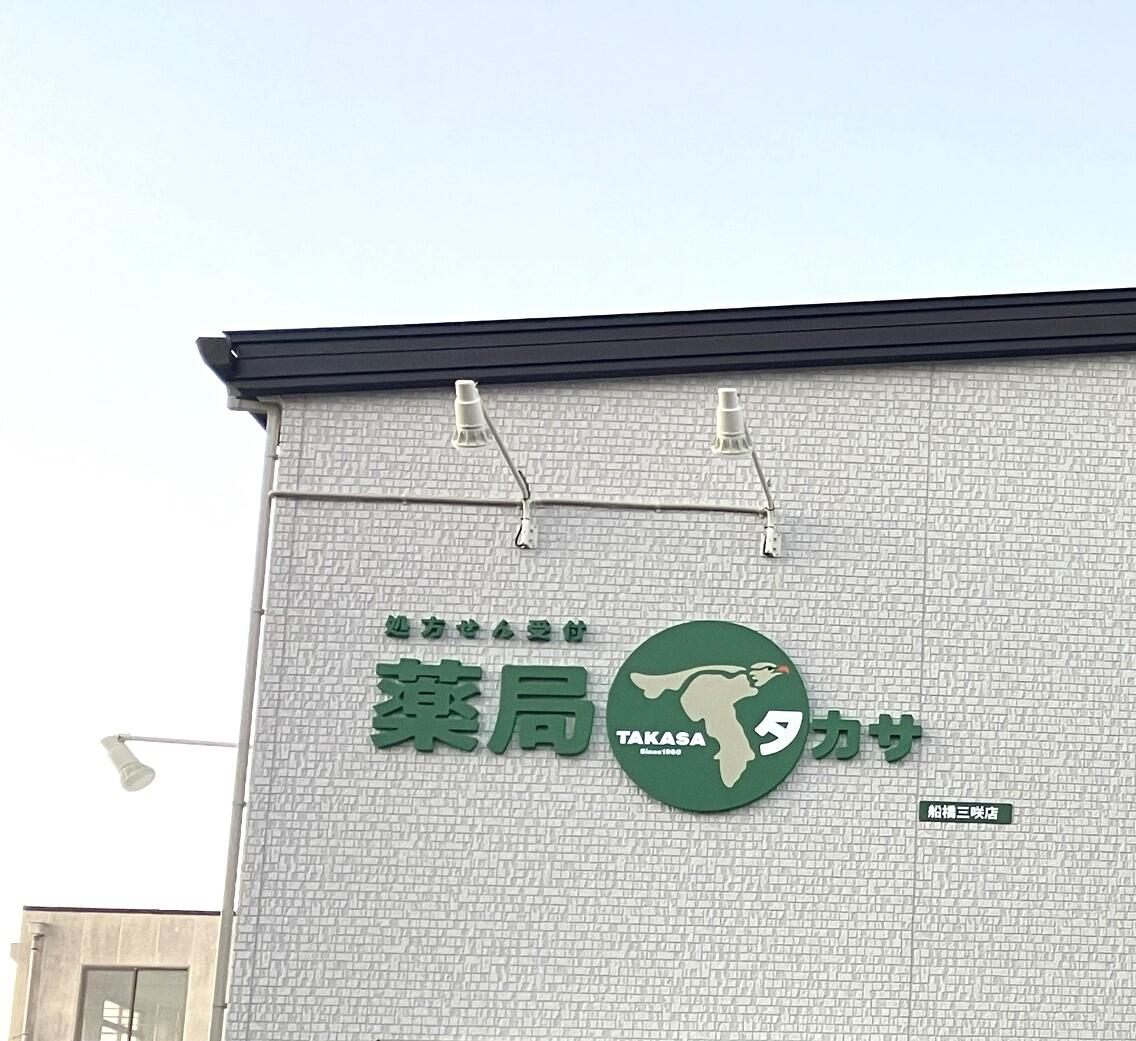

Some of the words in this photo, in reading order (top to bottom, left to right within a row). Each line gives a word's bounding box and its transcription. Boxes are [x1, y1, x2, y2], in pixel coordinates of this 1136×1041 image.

[384, 615, 588, 643] 処方せん受付
[371, 657, 596, 757] 薬局
[754, 710, 923, 763] タカサ
[615, 730, 707, 747] TAKASA
[927, 804, 1000, 820] 船橋三咲店
